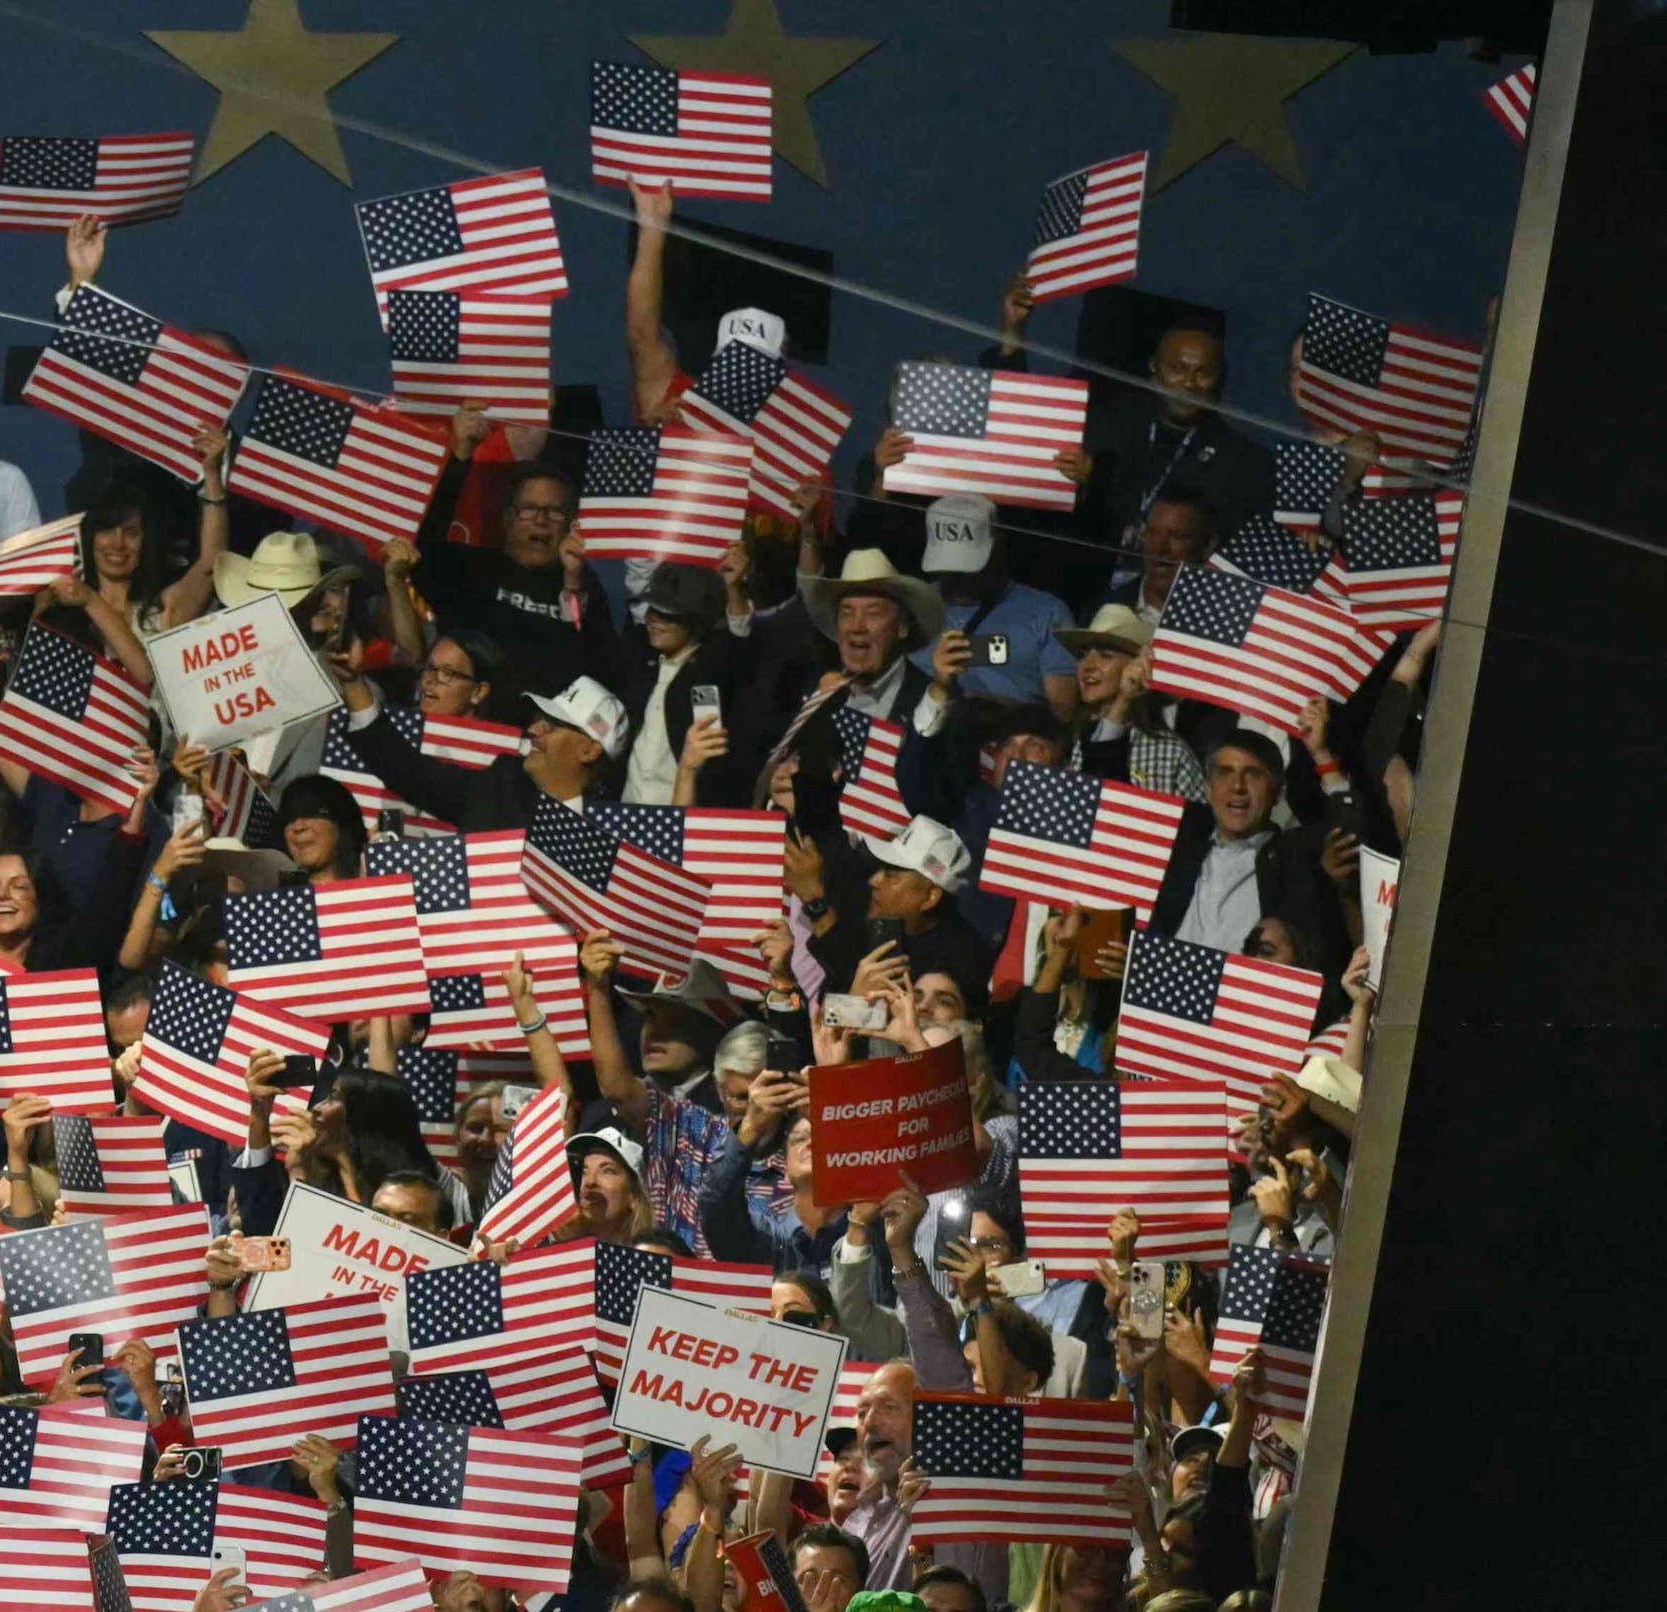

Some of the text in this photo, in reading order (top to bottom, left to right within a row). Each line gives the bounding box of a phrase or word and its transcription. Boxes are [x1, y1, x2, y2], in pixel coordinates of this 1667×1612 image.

[729, 319, 766, 340] USA
[935, 521, 974, 542] USA
[182, 624, 259, 674] MADE
[204, 662, 256, 693] IN THE
[214, 686, 277, 726] USA
[822, 1098, 894, 1122] BIGGER
[898, 1116, 929, 1138] FOR
[826, 1126, 972, 1168] WORKING FAMILIES
[322, 1223, 430, 1278] MADE
[331, 1265, 401, 1303] IN THE
[647, 1325, 820, 1394] KEEP THE
[628, 1369, 818, 1439] MAJORITY
[1005, 1396, 1040, 1405] DALLAS
